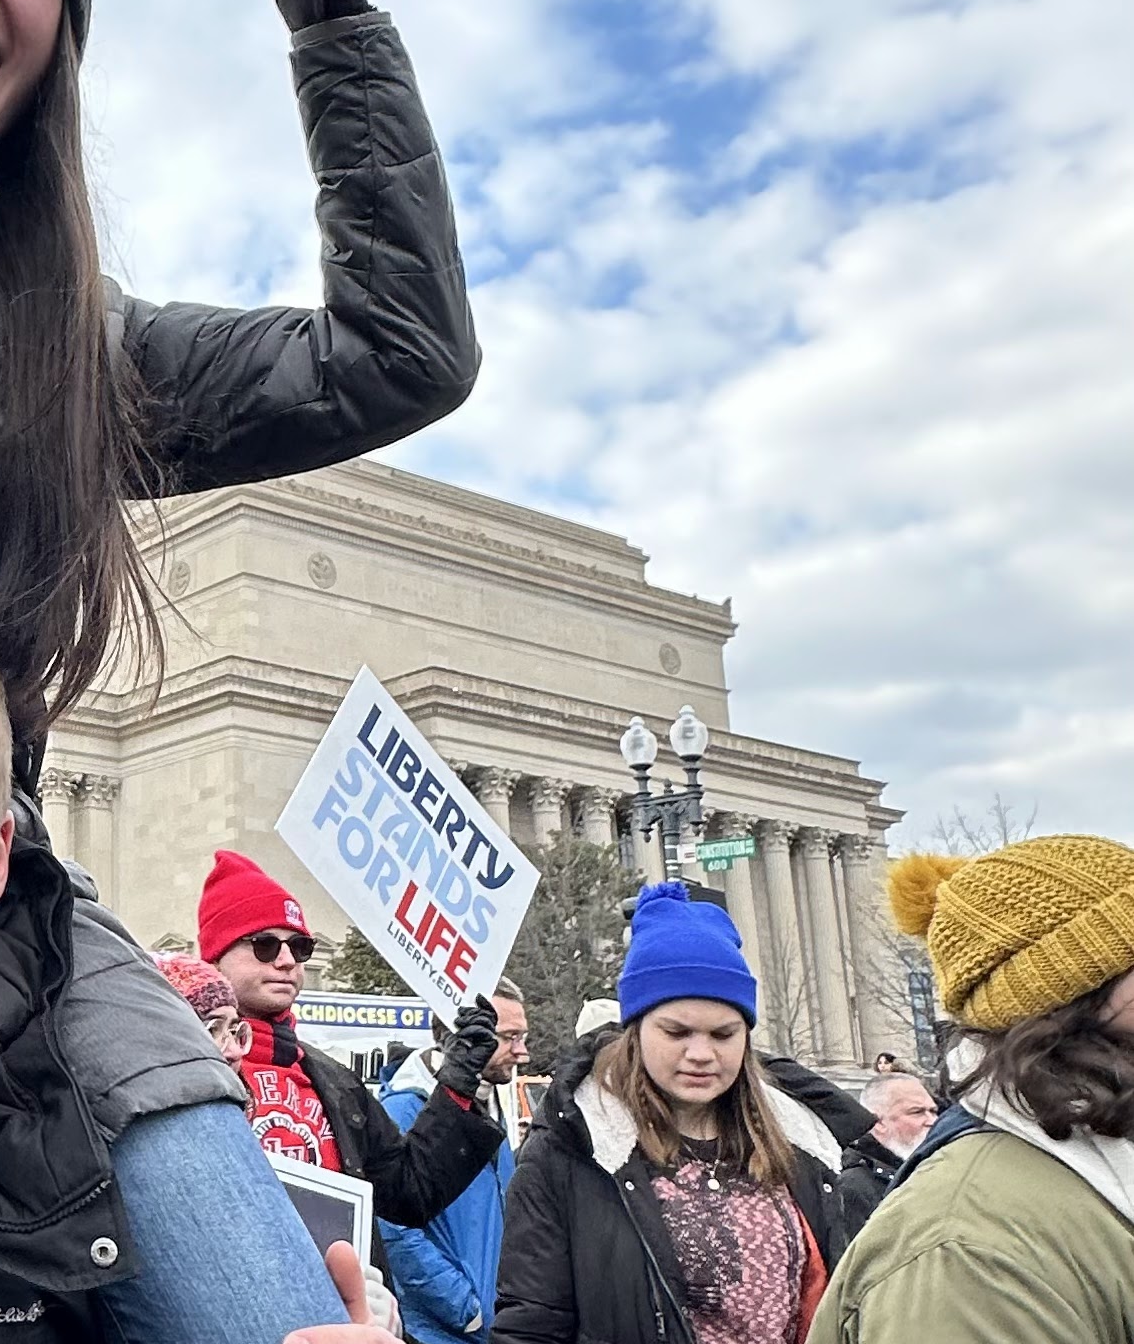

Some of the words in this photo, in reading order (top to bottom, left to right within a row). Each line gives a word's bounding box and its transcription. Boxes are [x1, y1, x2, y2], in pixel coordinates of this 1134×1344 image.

[311, 784, 401, 907] FOR
[394, 879, 479, 994] LIFE
[334, 746, 498, 945] STANDS
[356, 702, 516, 890] LIBERTY
[293, 1004, 397, 1027] RCHDIOCESE
[401, 1008, 425, 1027] OF
[386, 920, 463, 1007] LIBERTY.EDU
